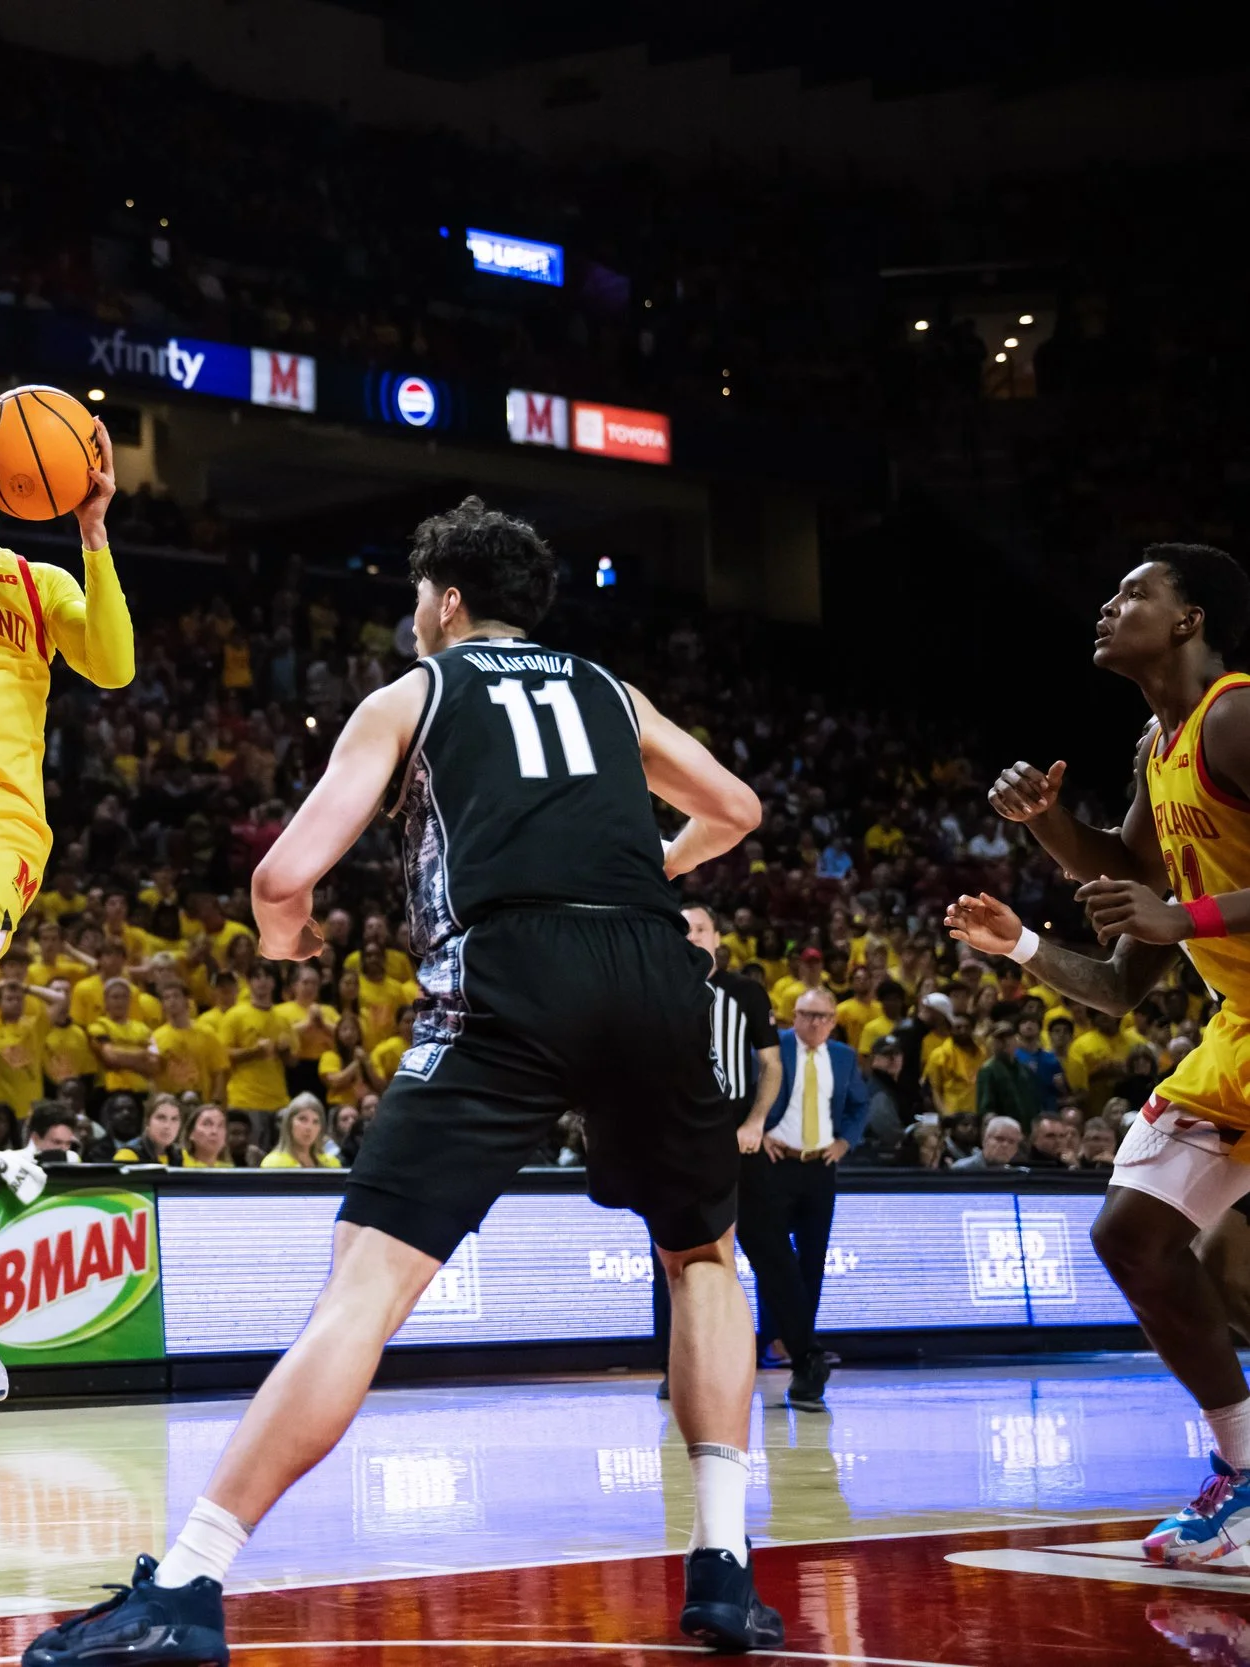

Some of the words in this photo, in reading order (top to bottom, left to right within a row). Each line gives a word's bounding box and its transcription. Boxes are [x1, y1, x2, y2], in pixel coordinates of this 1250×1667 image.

[88, 329, 205, 390] xfinity
[270, 352, 299, 400] M
[525, 391, 555, 441] M
[606, 422, 667, 449] TOYOTA
[462, 652, 573, 677] HALAIFONUA
[486, 677, 598, 778] 11
[988, 1229, 1046, 1259] BUD
[980, 1259, 1059, 1288] LIGHT
